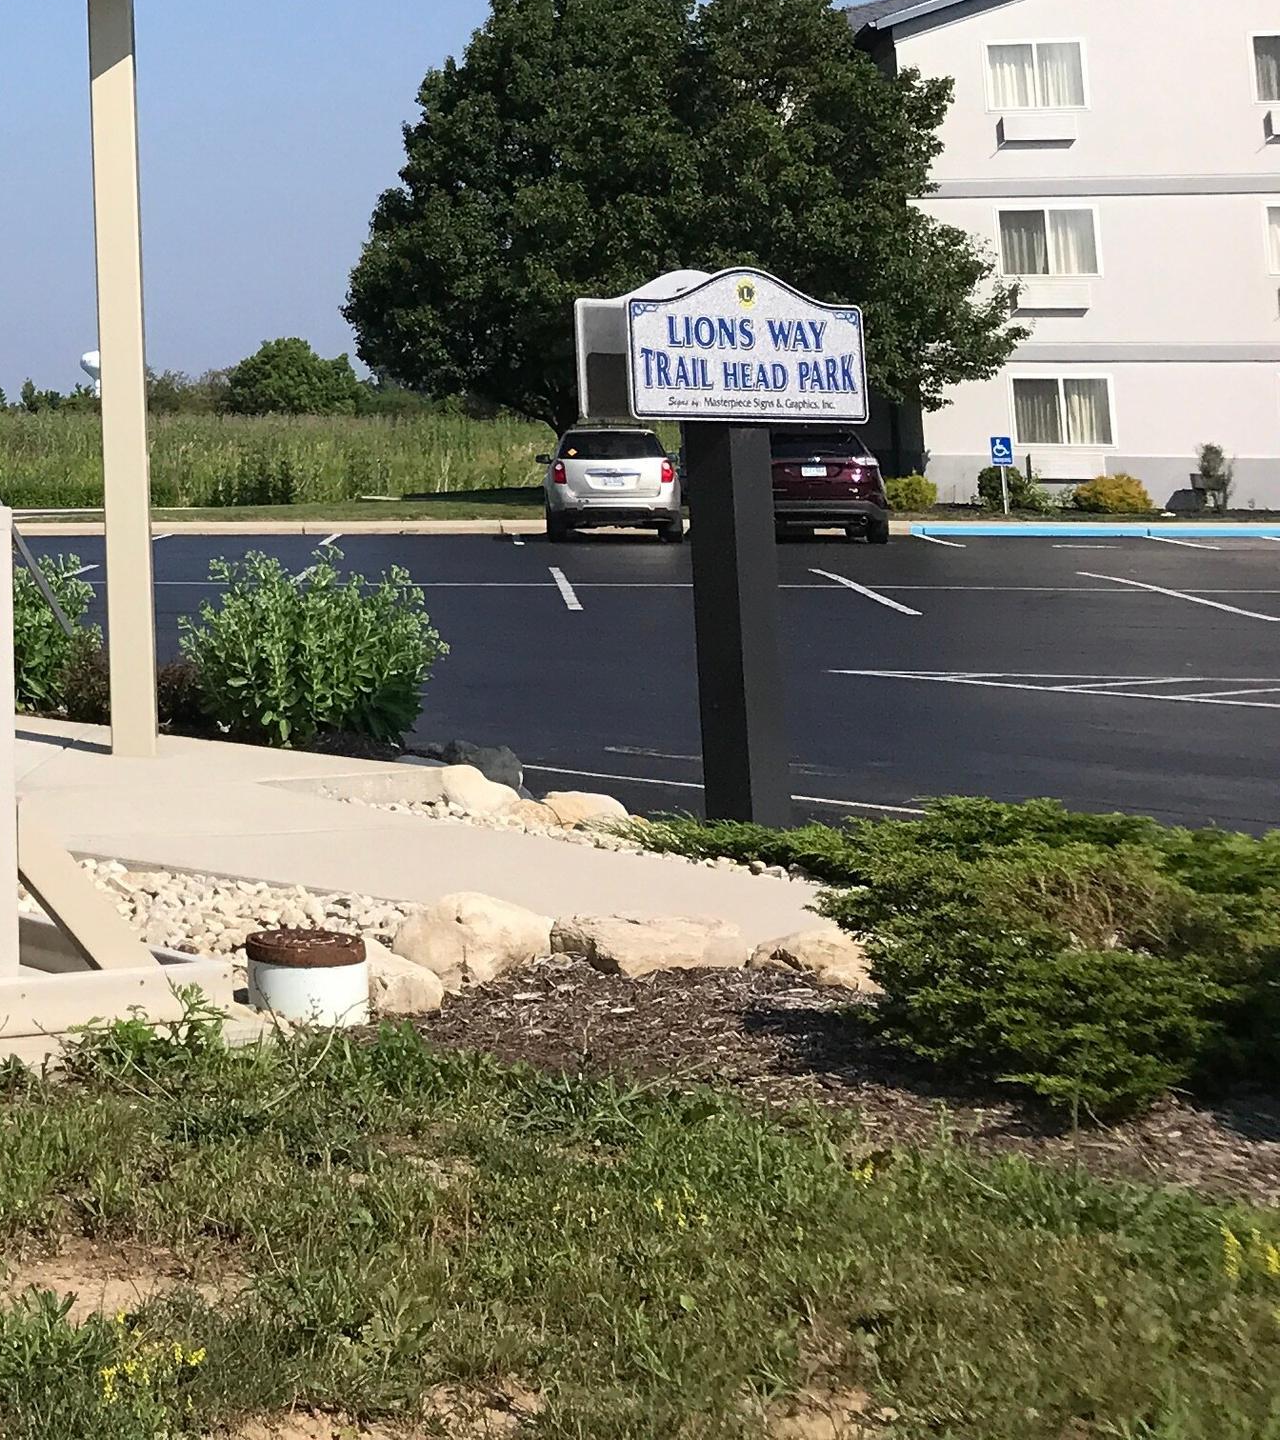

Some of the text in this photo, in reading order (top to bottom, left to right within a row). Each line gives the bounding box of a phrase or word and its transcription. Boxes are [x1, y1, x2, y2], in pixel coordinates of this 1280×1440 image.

[667, 315, 826, 351] LIONS WAY
[640, 347, 857, 393] TRAIL HEAD PARK
[704, 396, 752, 409] Masterpiece
[753, 397, 774, 410] Signs
[776, 398, 784, 408] &
